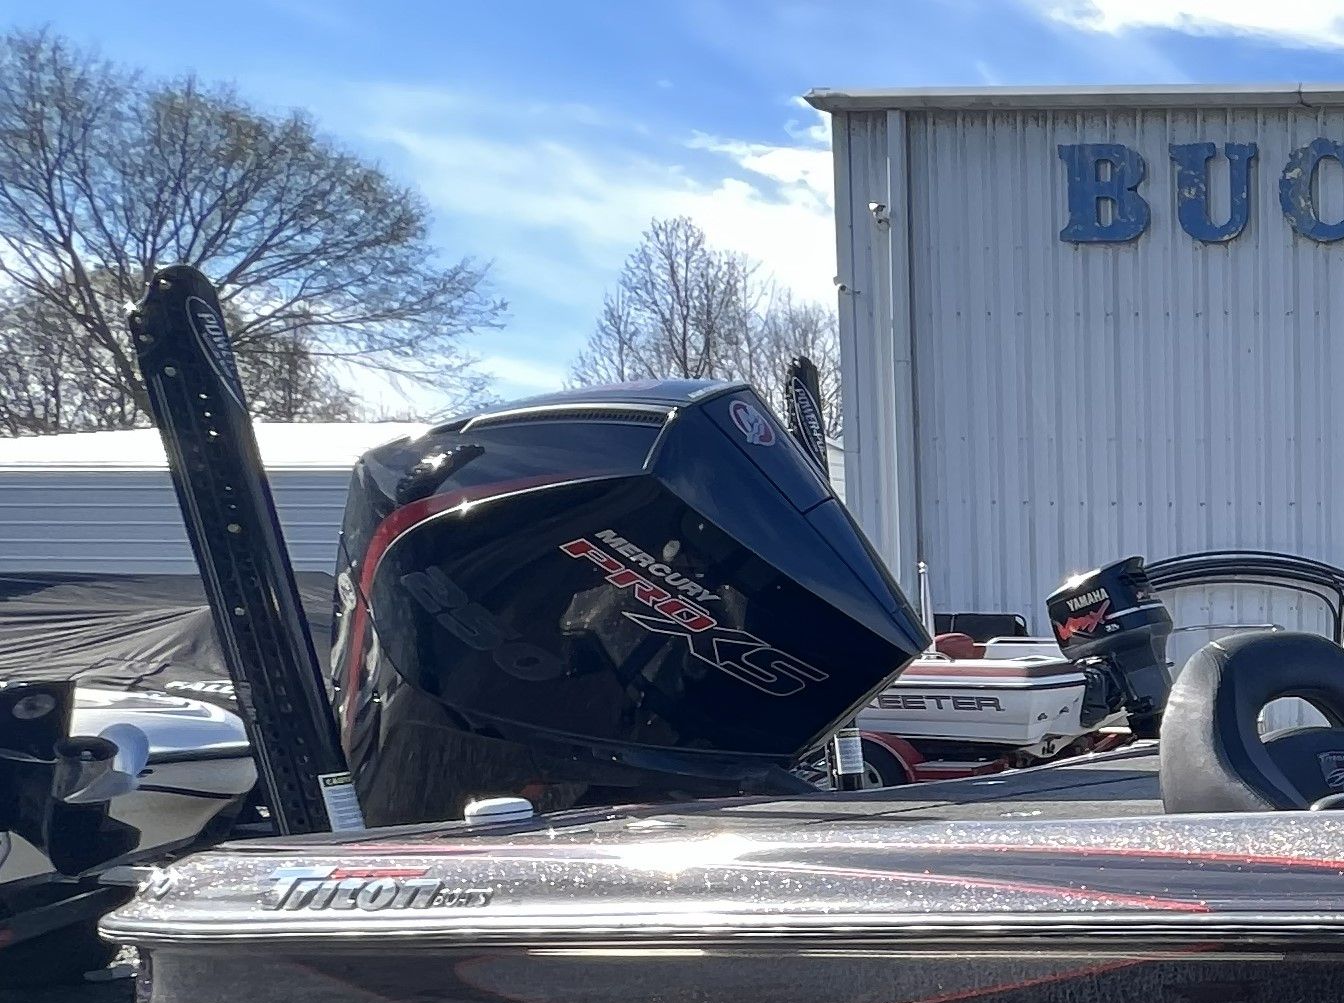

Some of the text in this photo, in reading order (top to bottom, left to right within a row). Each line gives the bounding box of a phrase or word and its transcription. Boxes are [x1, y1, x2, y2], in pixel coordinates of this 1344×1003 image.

[595, 529, 721, 602] MERCURY
[559, 538, 830, 696] PRO XS
[1065, 587, 1110, 612] YAMAHA
[866, 694, 1005, 713] EETER
[263, 865, 446, 912] Triton
